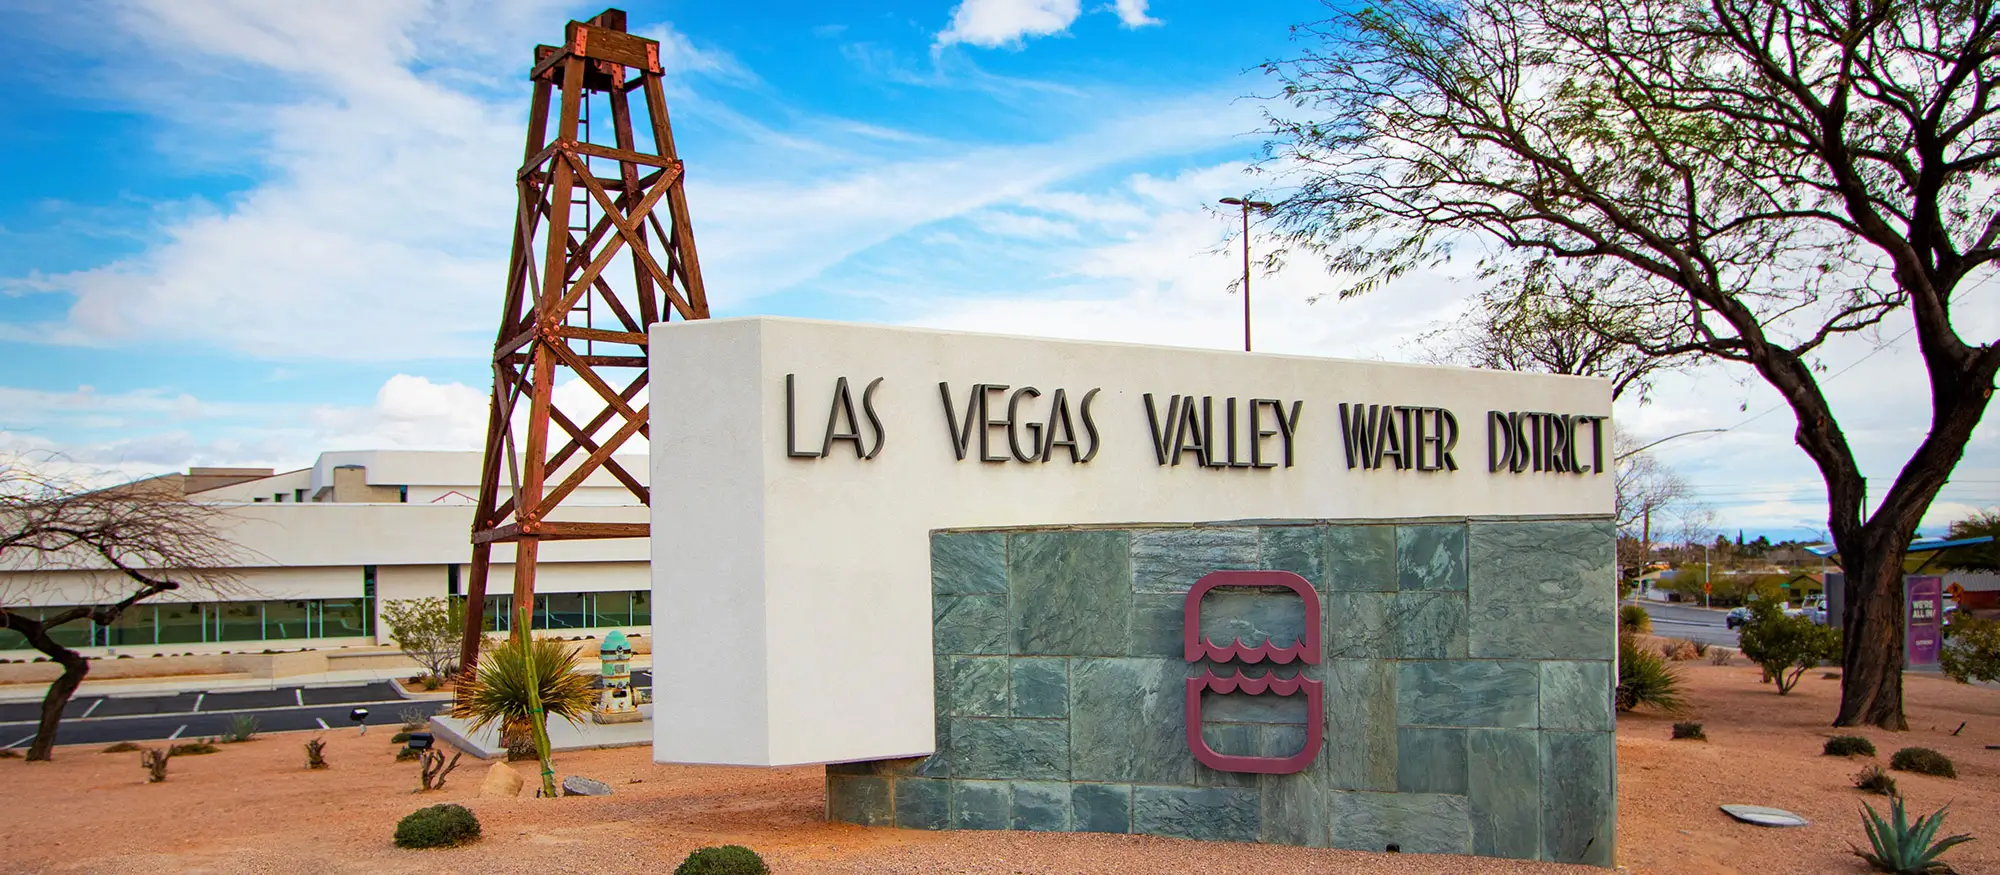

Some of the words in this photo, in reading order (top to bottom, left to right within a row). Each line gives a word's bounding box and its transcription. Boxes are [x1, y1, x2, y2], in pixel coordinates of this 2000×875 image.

[786, 373, 885, 460] LAS
[938, 381, 1101, 463] VEGAS
[1143, 392, 1304, 468] VALLEY
[1339, 402, 1460, 471] WATER
[1487, 410, 1609, 475] DISTRICT
[1911, 609, 1925, 618] ALL
